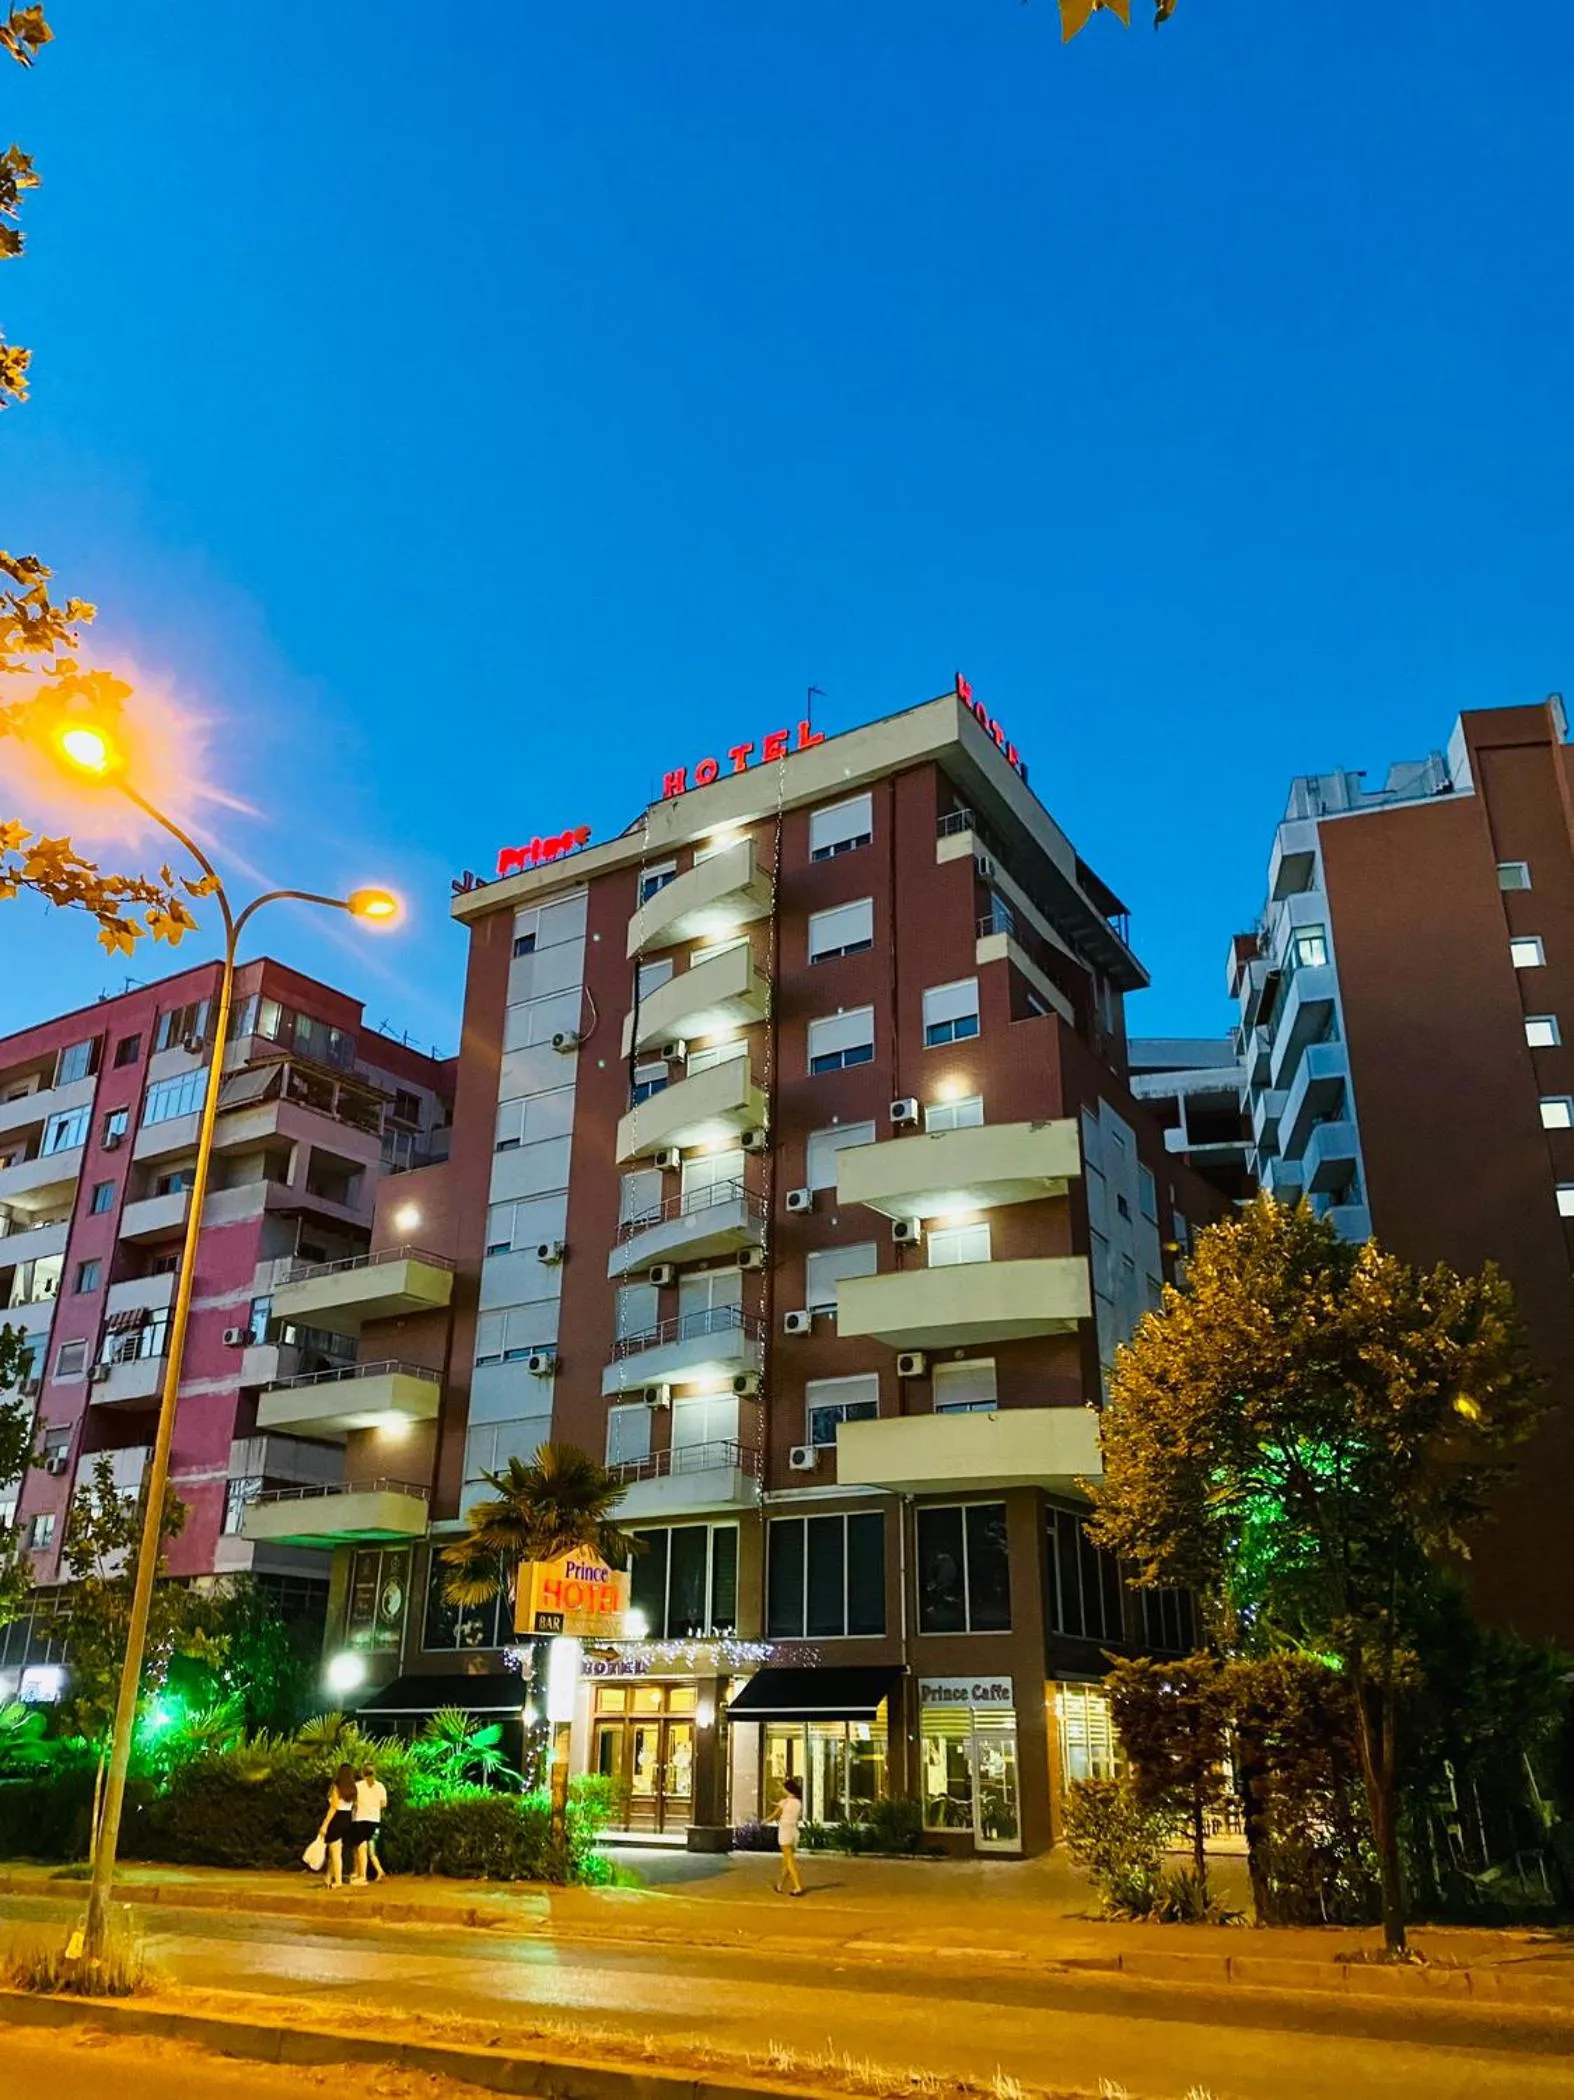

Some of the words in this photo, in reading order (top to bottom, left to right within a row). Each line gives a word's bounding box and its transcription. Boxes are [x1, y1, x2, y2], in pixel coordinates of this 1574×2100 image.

[662, 720, 825, 800] HOTEL
[565, 1560, 608, 1582] Prince
[543, 1578, 624, 1615] HOTEL
[539, 1615, 560, 1631] BAR
[582, 1660, 648, 1676] HOTEL
[921, 1684, 969, 1701] Prince
[972, 1684, 1010, 1700] Caffe
